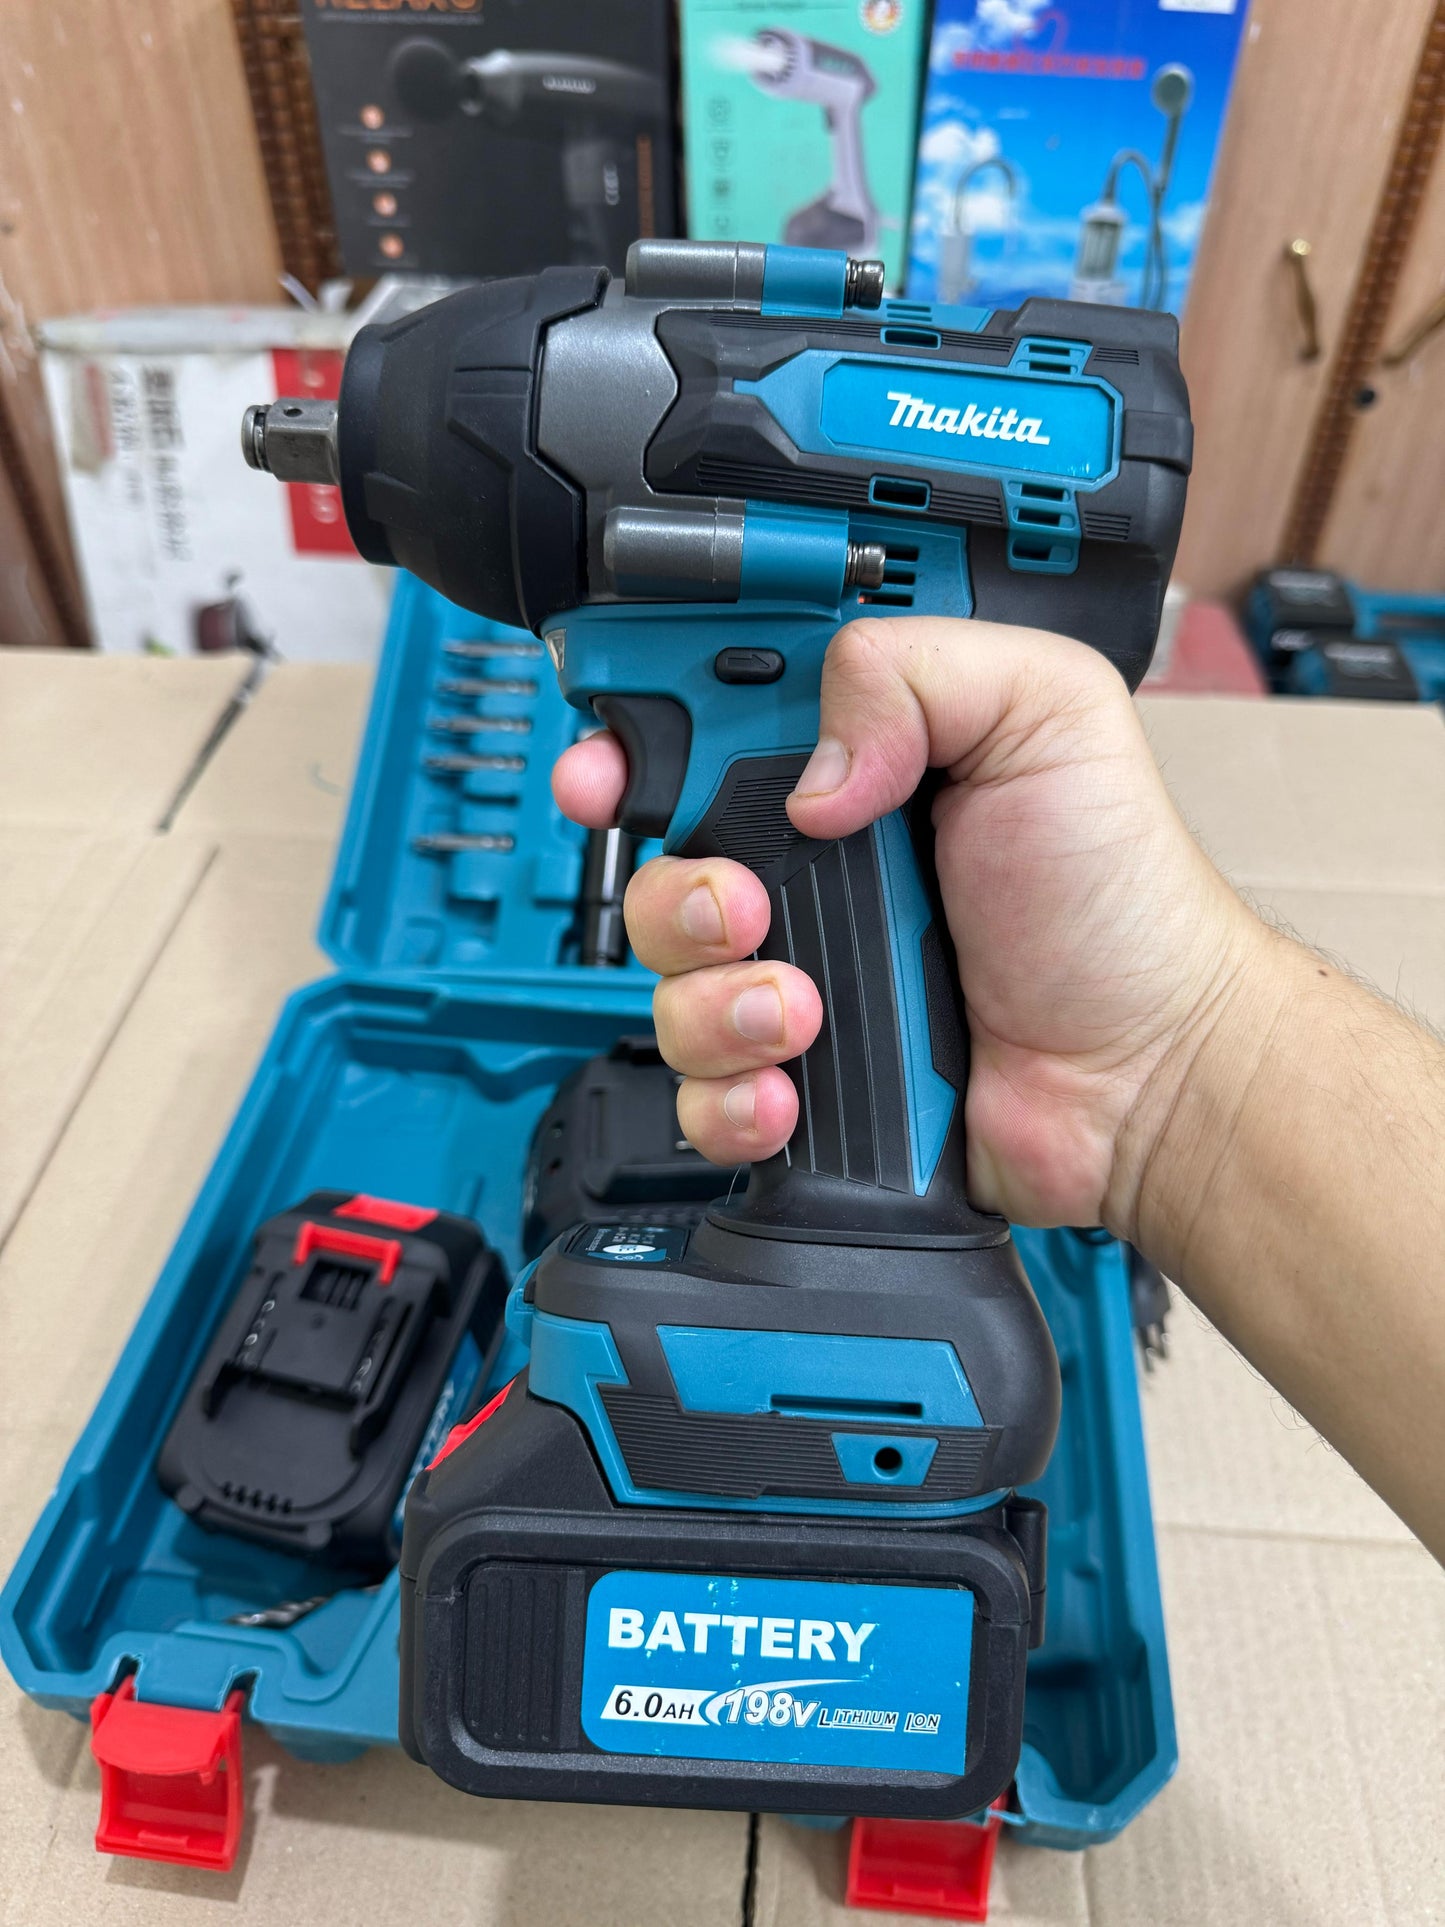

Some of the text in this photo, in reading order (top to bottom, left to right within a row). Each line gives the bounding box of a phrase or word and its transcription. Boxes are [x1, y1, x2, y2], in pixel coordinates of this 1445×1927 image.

[608, 1607, 877, 1662] BATTERY
[615, 1689, 694, 1720] 6.0AH
[817, 1708, 899, 1731] LITHIUM
[904, 1712, 941, 1734] ION
